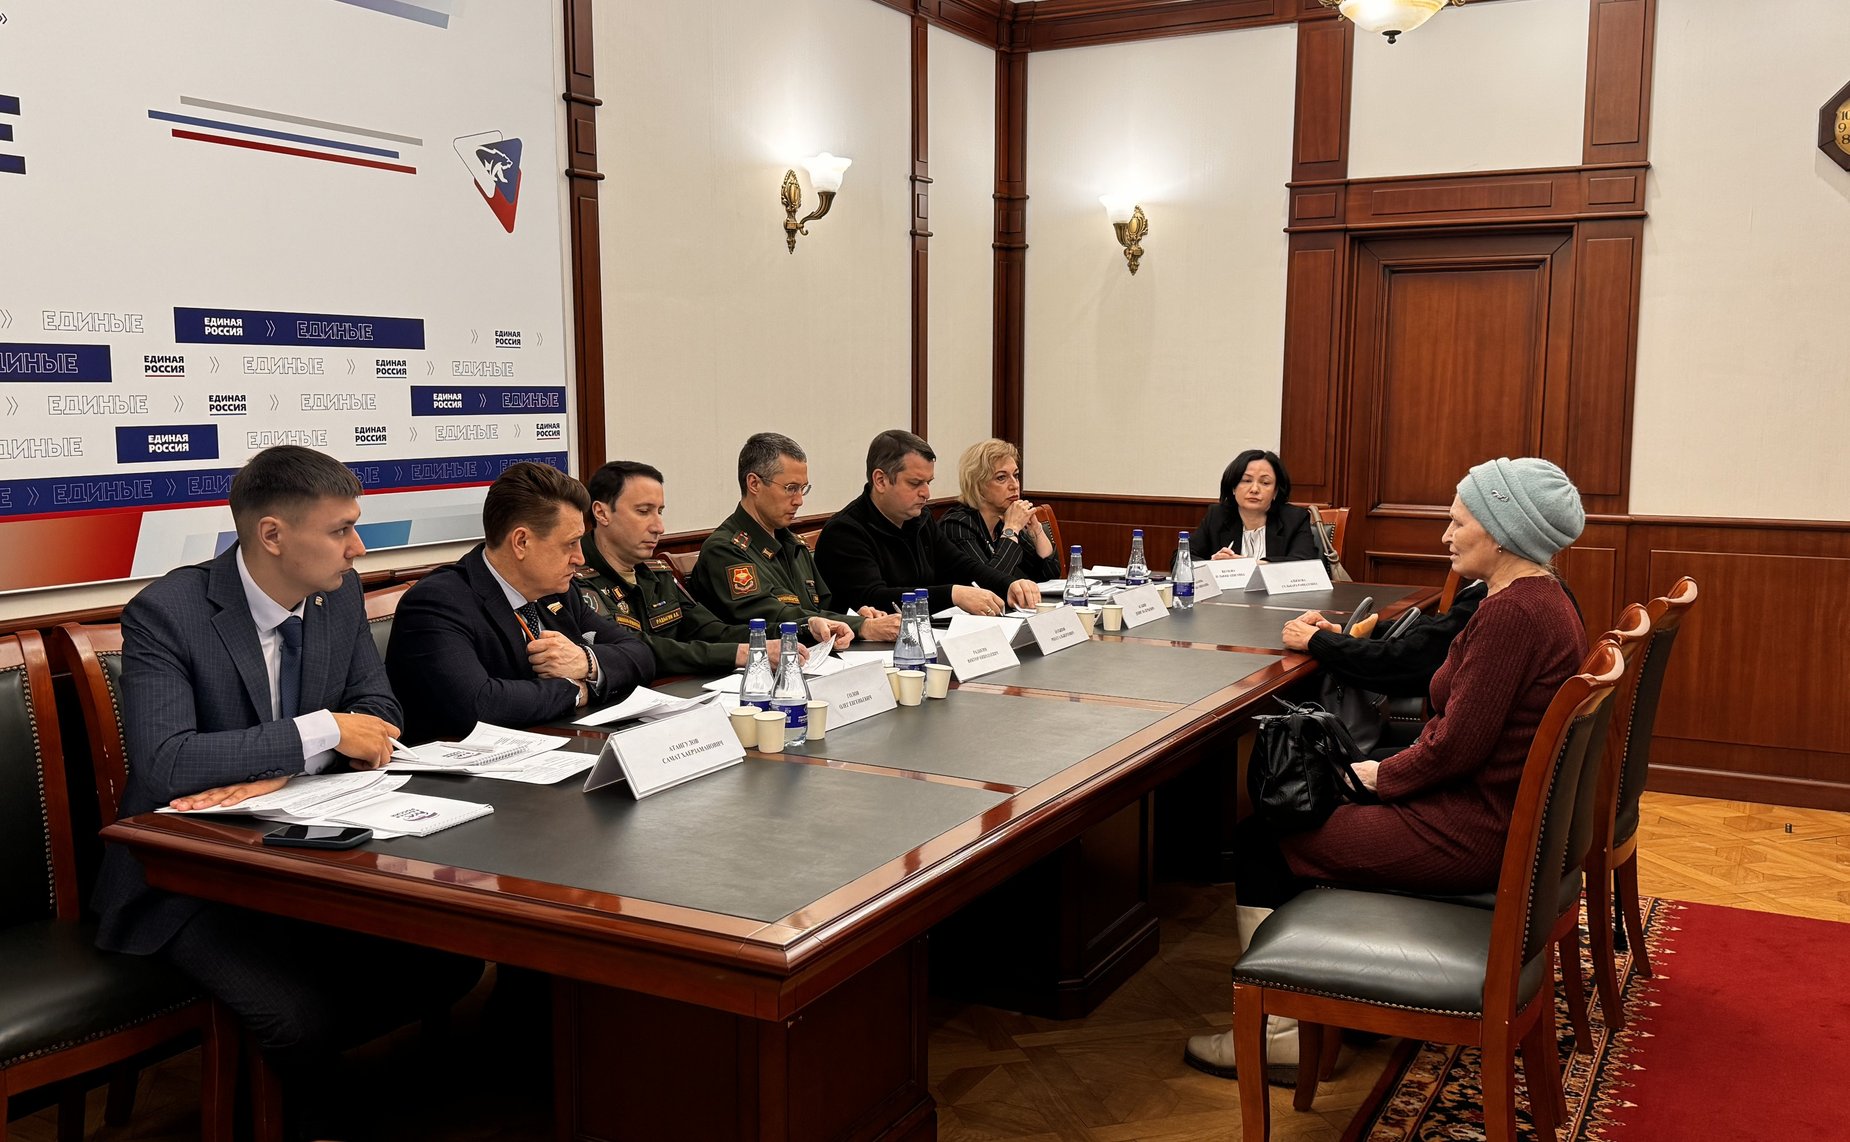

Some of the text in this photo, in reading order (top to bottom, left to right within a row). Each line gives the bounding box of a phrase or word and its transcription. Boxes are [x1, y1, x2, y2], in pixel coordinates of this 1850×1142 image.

[1838, 122, 1847, 134] 9
[1842, 134, 1850, 144] 8
[42, 310, 144, 334] ЕДИНЫЕ
[204, 317, 243, 327] ЕДИНАЯ
[204, 326, 243, 336] РОССИЯ
[296, 320, 374, 341] ЕДИНЫЕ
[495, 330, 521, 338] ЕДИНАЯ
[495, 338, 521, 346] РОССИЯ
[144, 355, 184, 364] ЕДИНАЯ
[376, 359, 407, 367] ЕДИНАЯ
[144, 364, 185, 374] РОССИЯ
[243, 356, 324, 375] ЕДИНЫЕ
[452, 360, 514, 377] ЕДИНЫЕ
[376, 367, 407, 376] РОССИЯ
[208, 394, 246, 403] ЕДИНАЯ
[301, 393, 376, 411] ЕДИНЫЕ
[433, 393, 462, 401] ЕДИНАЯ
[502, 392, 560, 408] ЕДИНЫЕ
[48, 394, 149, 416] ЕДИНЫЕ
[209, 402, 247, 412] РОССИЯ
[433, 400, 463, 409] РОССИЯ
[354, 426, 387, 434] ЕДИНАЯ
[435, 424, 499, 441] ЕДИНЫЕ
[148, 434, 189, 444] ЕДИНАЯ
[246, 430, 328, 450] ЕДИНЫЕ
[355, 434, 387, 443] РОССИЯ
[148, 443, 189, 453] РОССИЯ
[411, 461, 477, 481] ЕДИНЫЕ
[188, 474, 237, 496] ЕДИ
[53, 479, 153, 505] ЕДИНЫЕ
[668, 738, 700, 752] АТАНГУЛОВ
[662, 754, 681, 764] САМАТ
